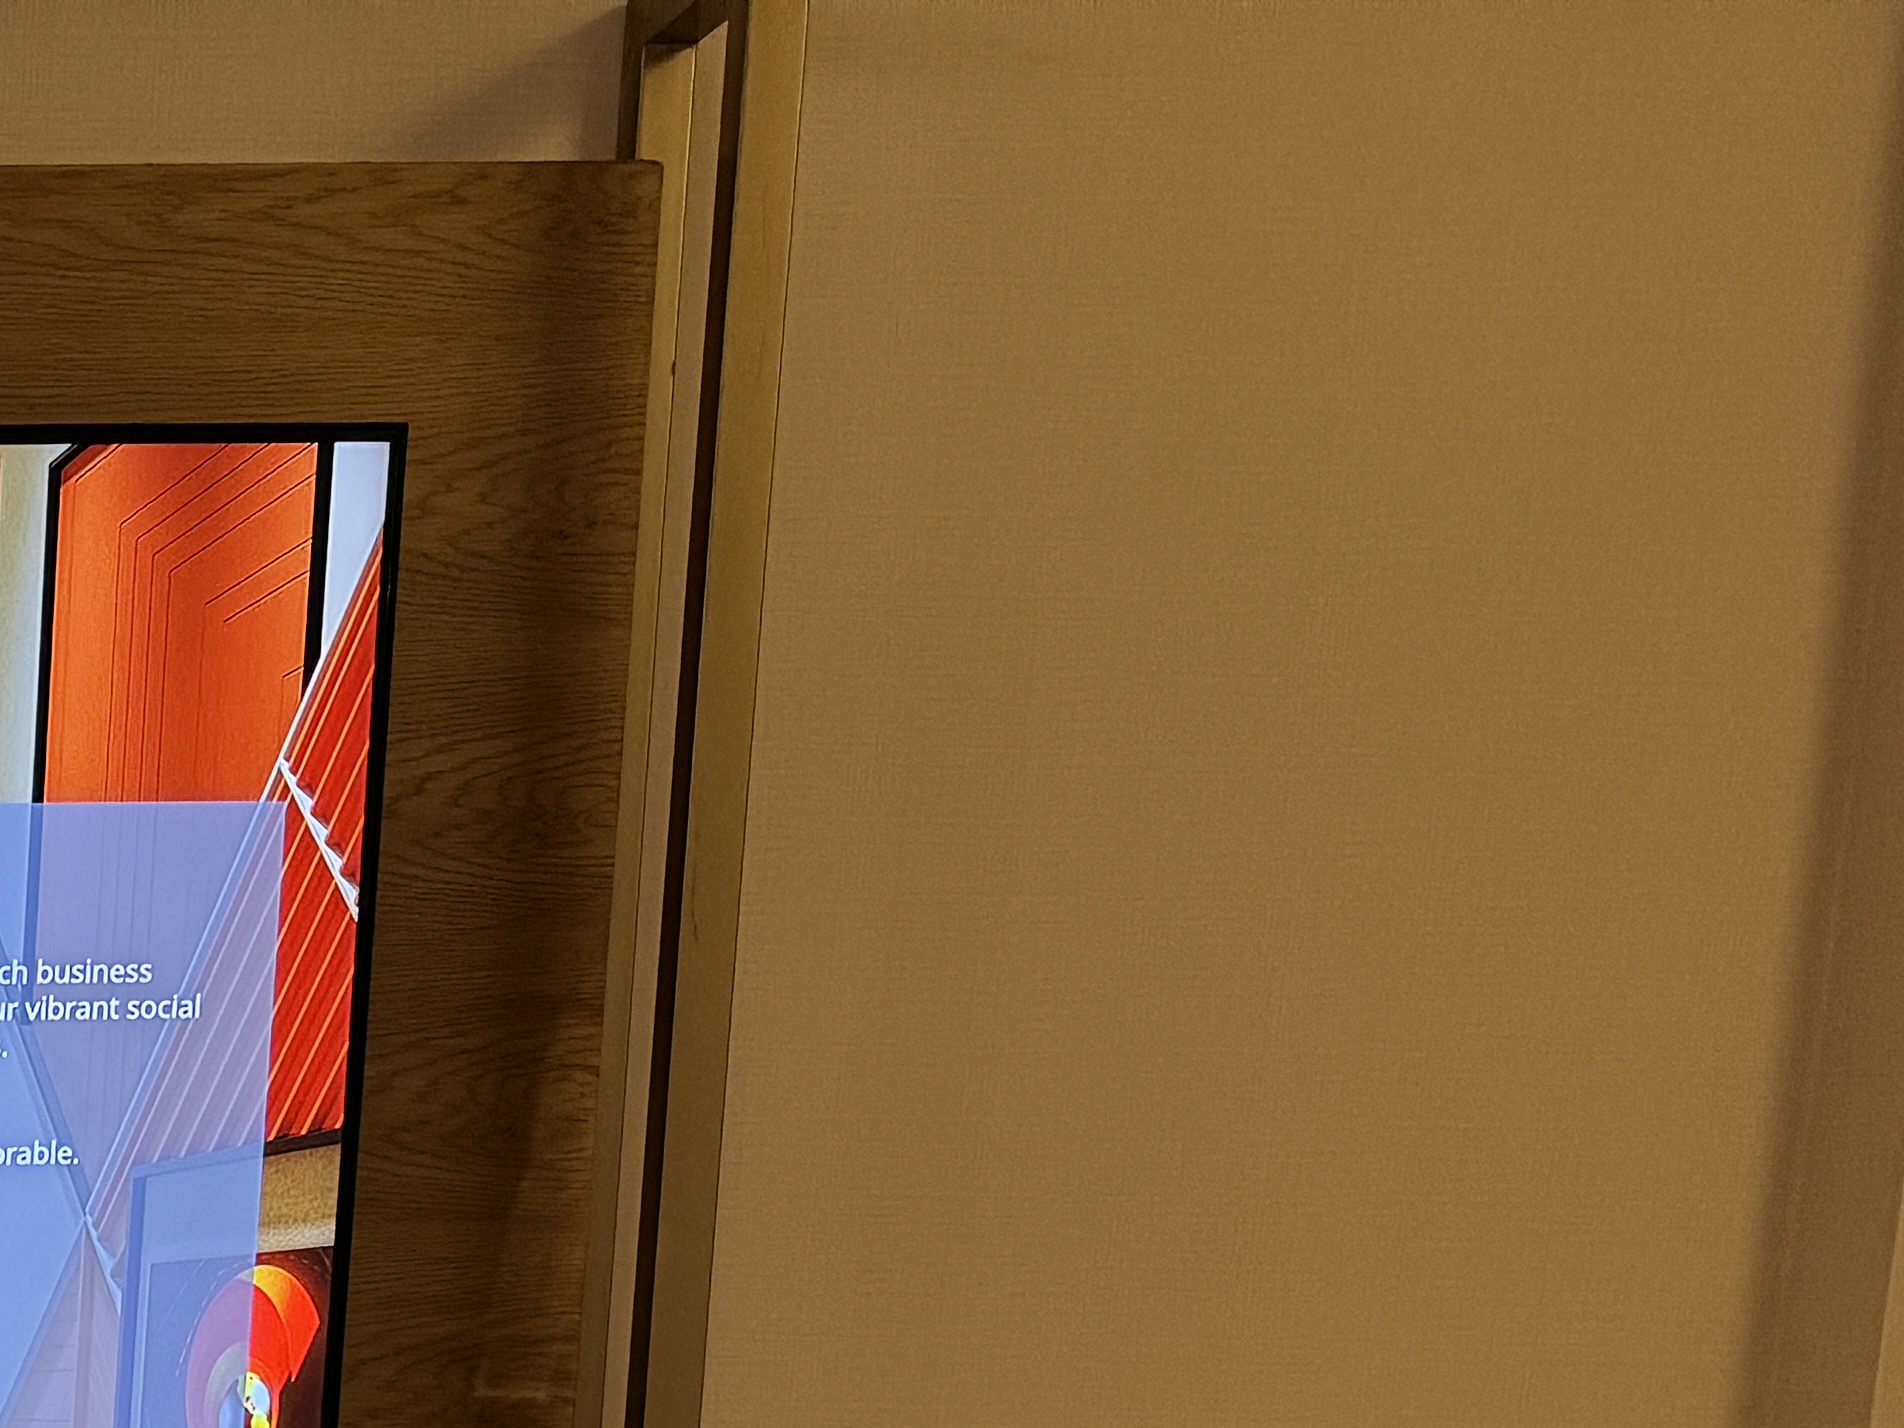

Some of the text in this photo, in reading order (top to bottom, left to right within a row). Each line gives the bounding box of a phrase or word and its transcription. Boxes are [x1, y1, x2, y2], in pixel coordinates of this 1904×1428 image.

[36, 958, 153, 985] business
[24, 993, 120, 1022] vibrant
[125, 992, 202, 1020] social
